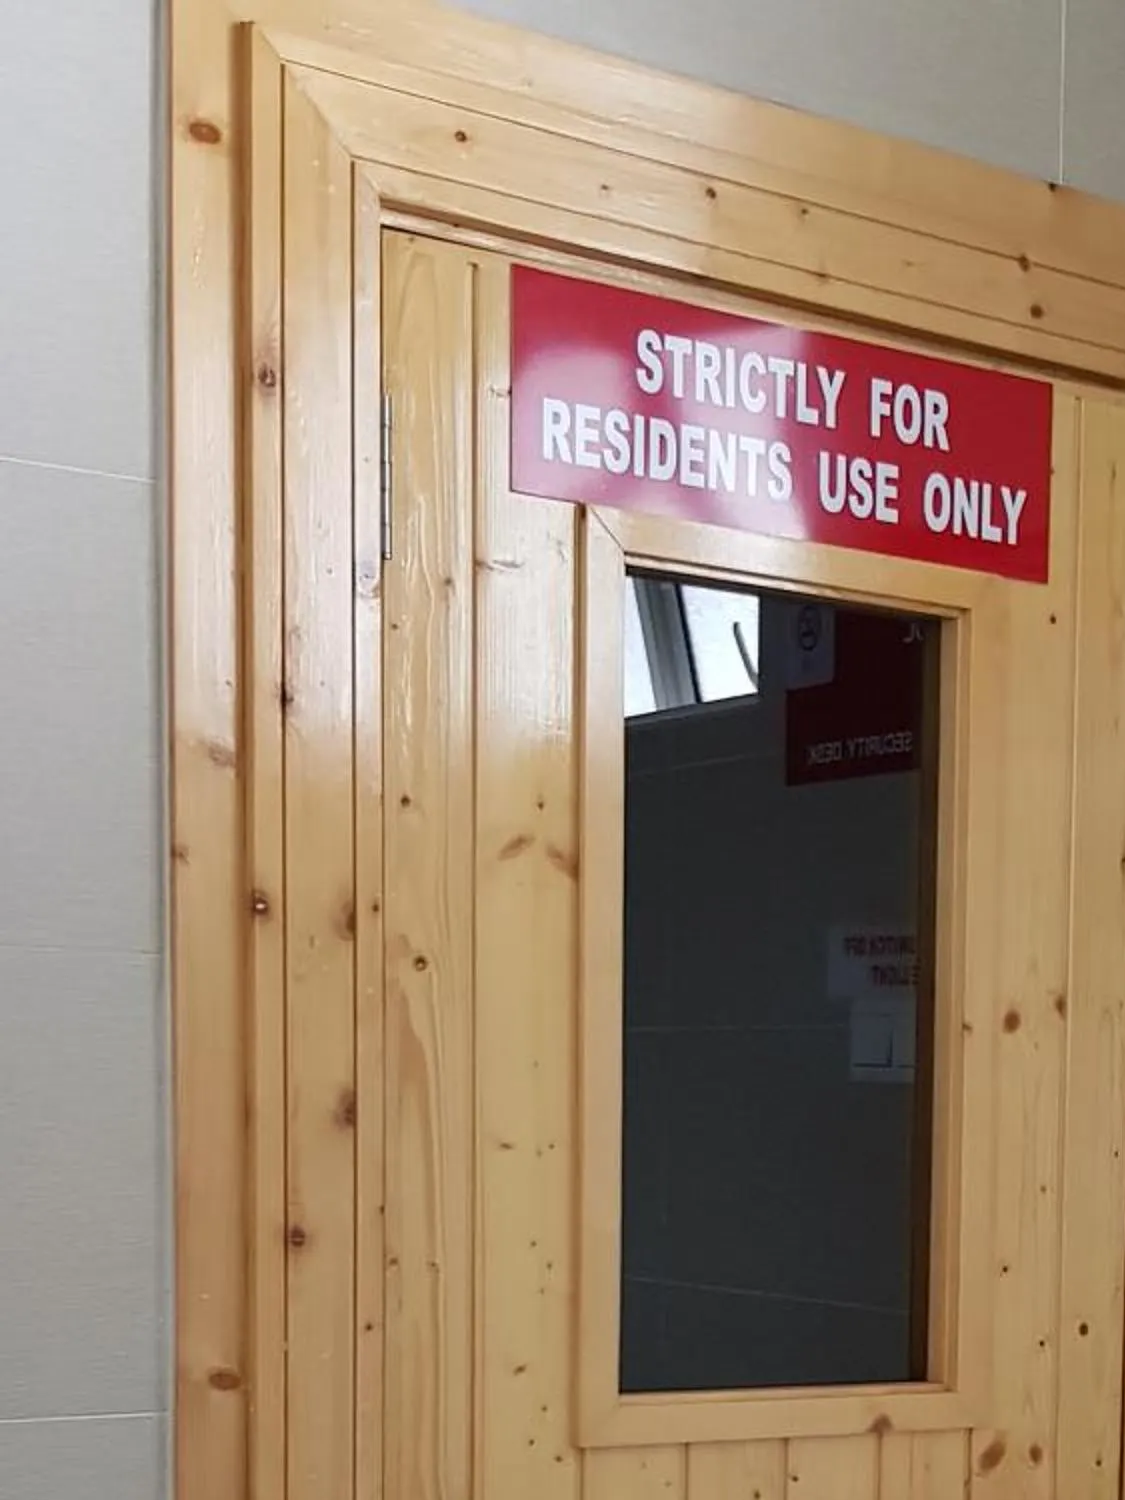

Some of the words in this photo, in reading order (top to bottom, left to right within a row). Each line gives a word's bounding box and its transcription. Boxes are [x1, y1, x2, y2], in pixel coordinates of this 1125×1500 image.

[636, 329, 847, 429] STRICTLY
[871, 378, 950, 451] FOR
[542, 397, 793, 500] RESIDENTS
[819, 451, 899, 524] USE
[923, 473, 1027, 545] ONLY
